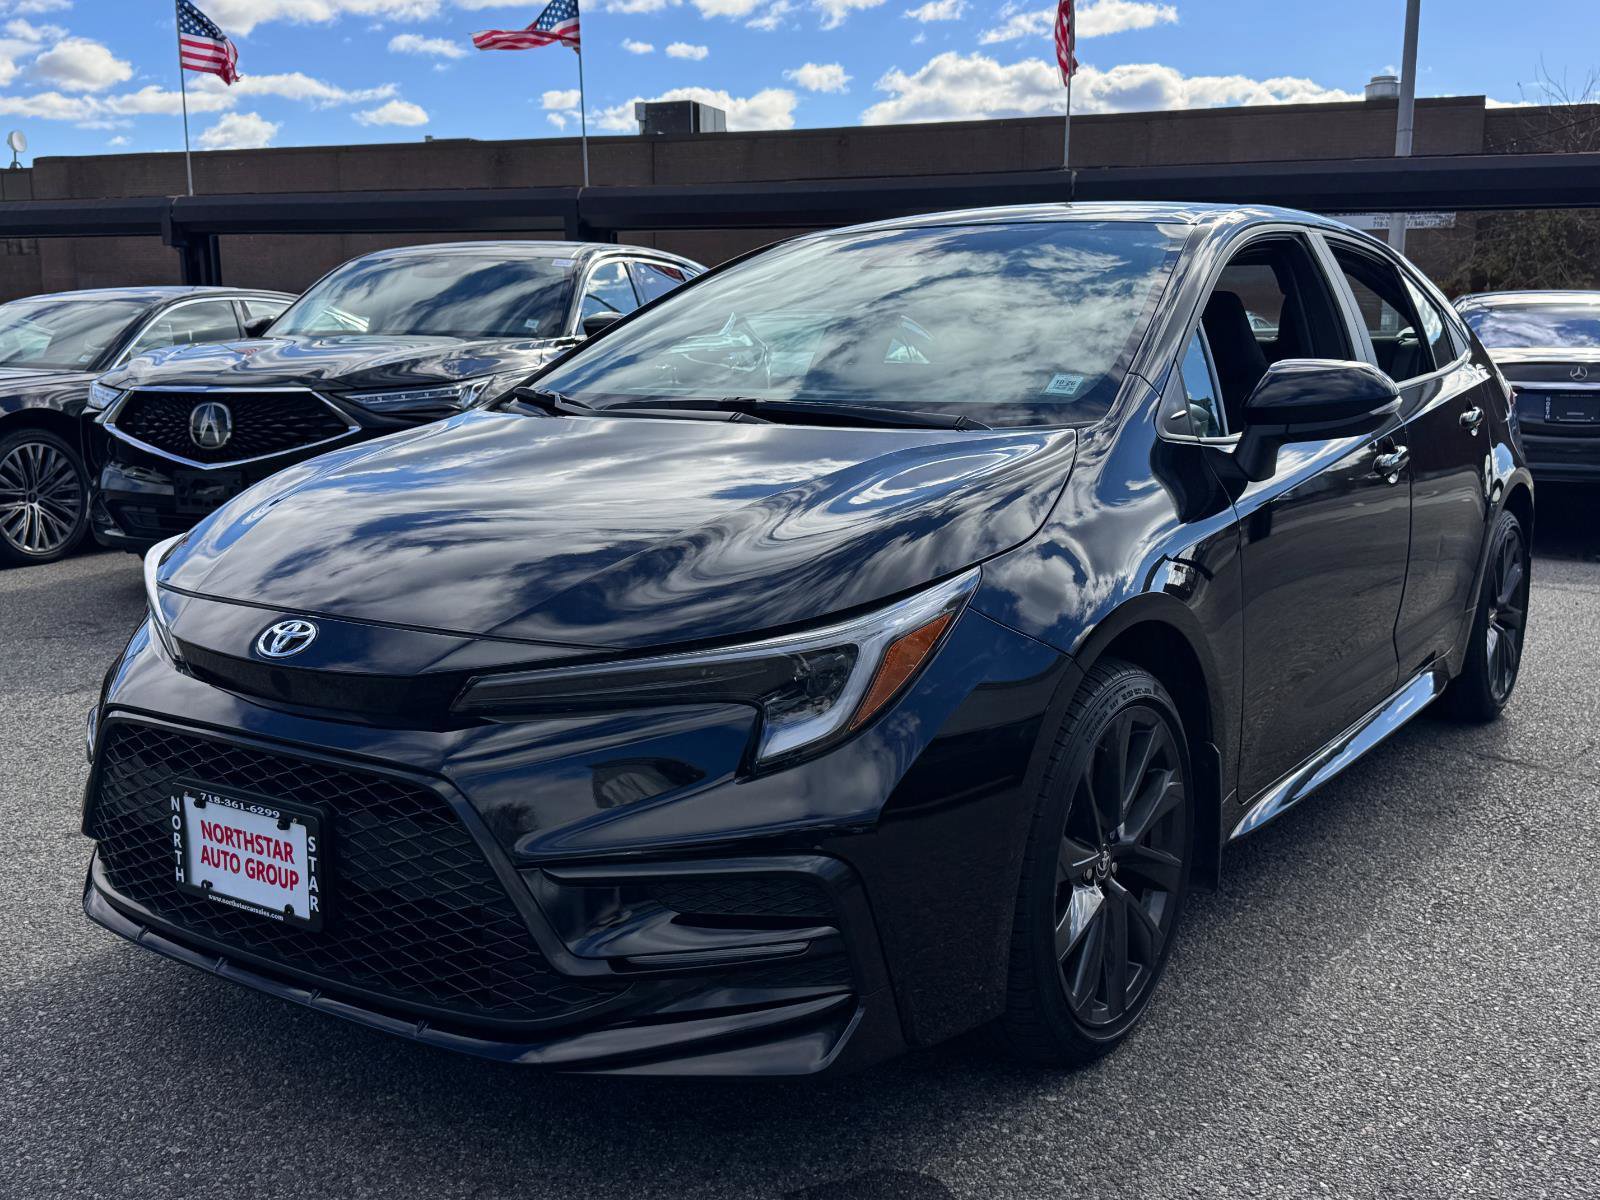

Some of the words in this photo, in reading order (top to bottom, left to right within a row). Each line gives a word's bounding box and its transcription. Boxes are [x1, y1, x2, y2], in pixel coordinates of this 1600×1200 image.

[199, 791, 281, 819] 718-361-6299
[170, 796, 185, 883] NORTH
[200, 820, 295, 865] NORTHSTAR
[200, 845, 241, 874] AUTO
[245, 857, 300, 891] GROUP
[307, 836, 320, 913] STAR
